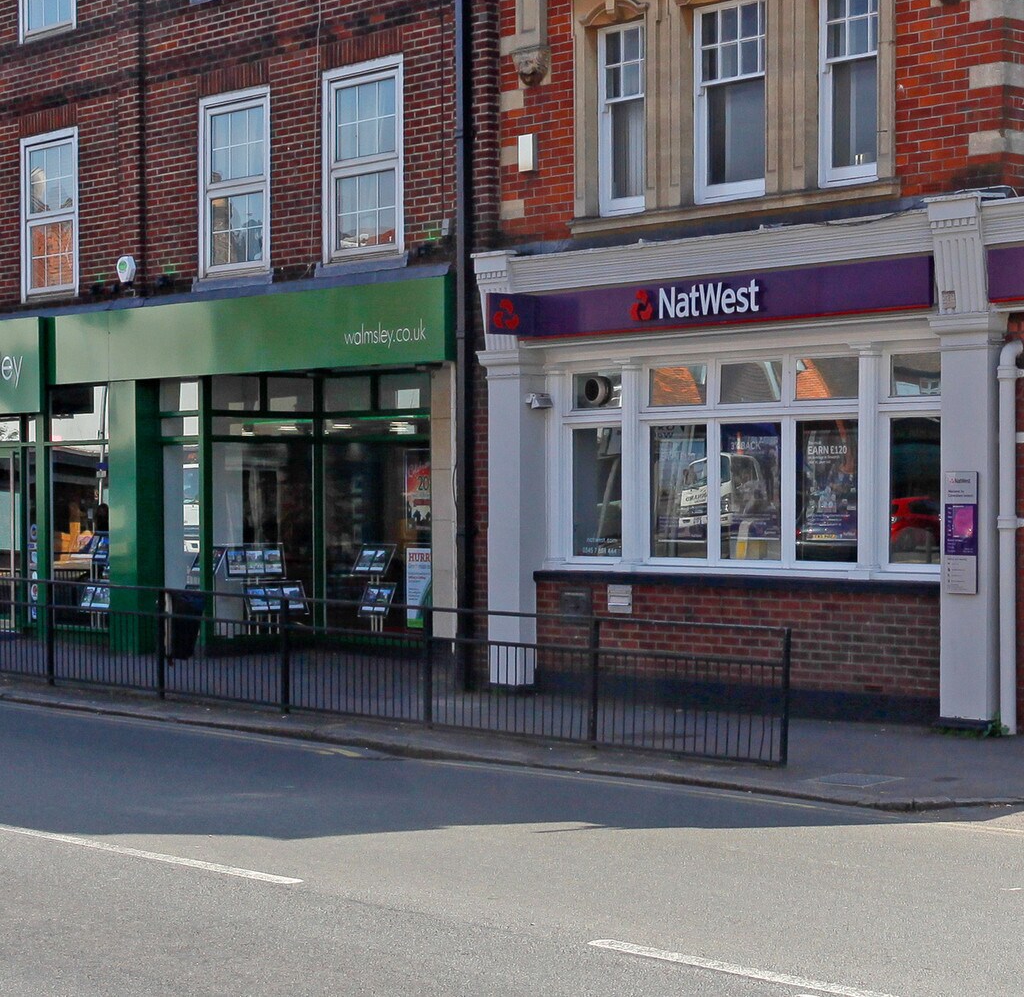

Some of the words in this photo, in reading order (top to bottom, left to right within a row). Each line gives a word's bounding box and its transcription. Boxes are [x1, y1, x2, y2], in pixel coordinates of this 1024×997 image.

[659, 279, 760, 320] NatWest
[344, 318, 427, 349] walmsley.co.uk
[807, 445, 829, 455] EARN
[830, 445, 848, 454] £120
[408, 552, 431, 562] HURR
